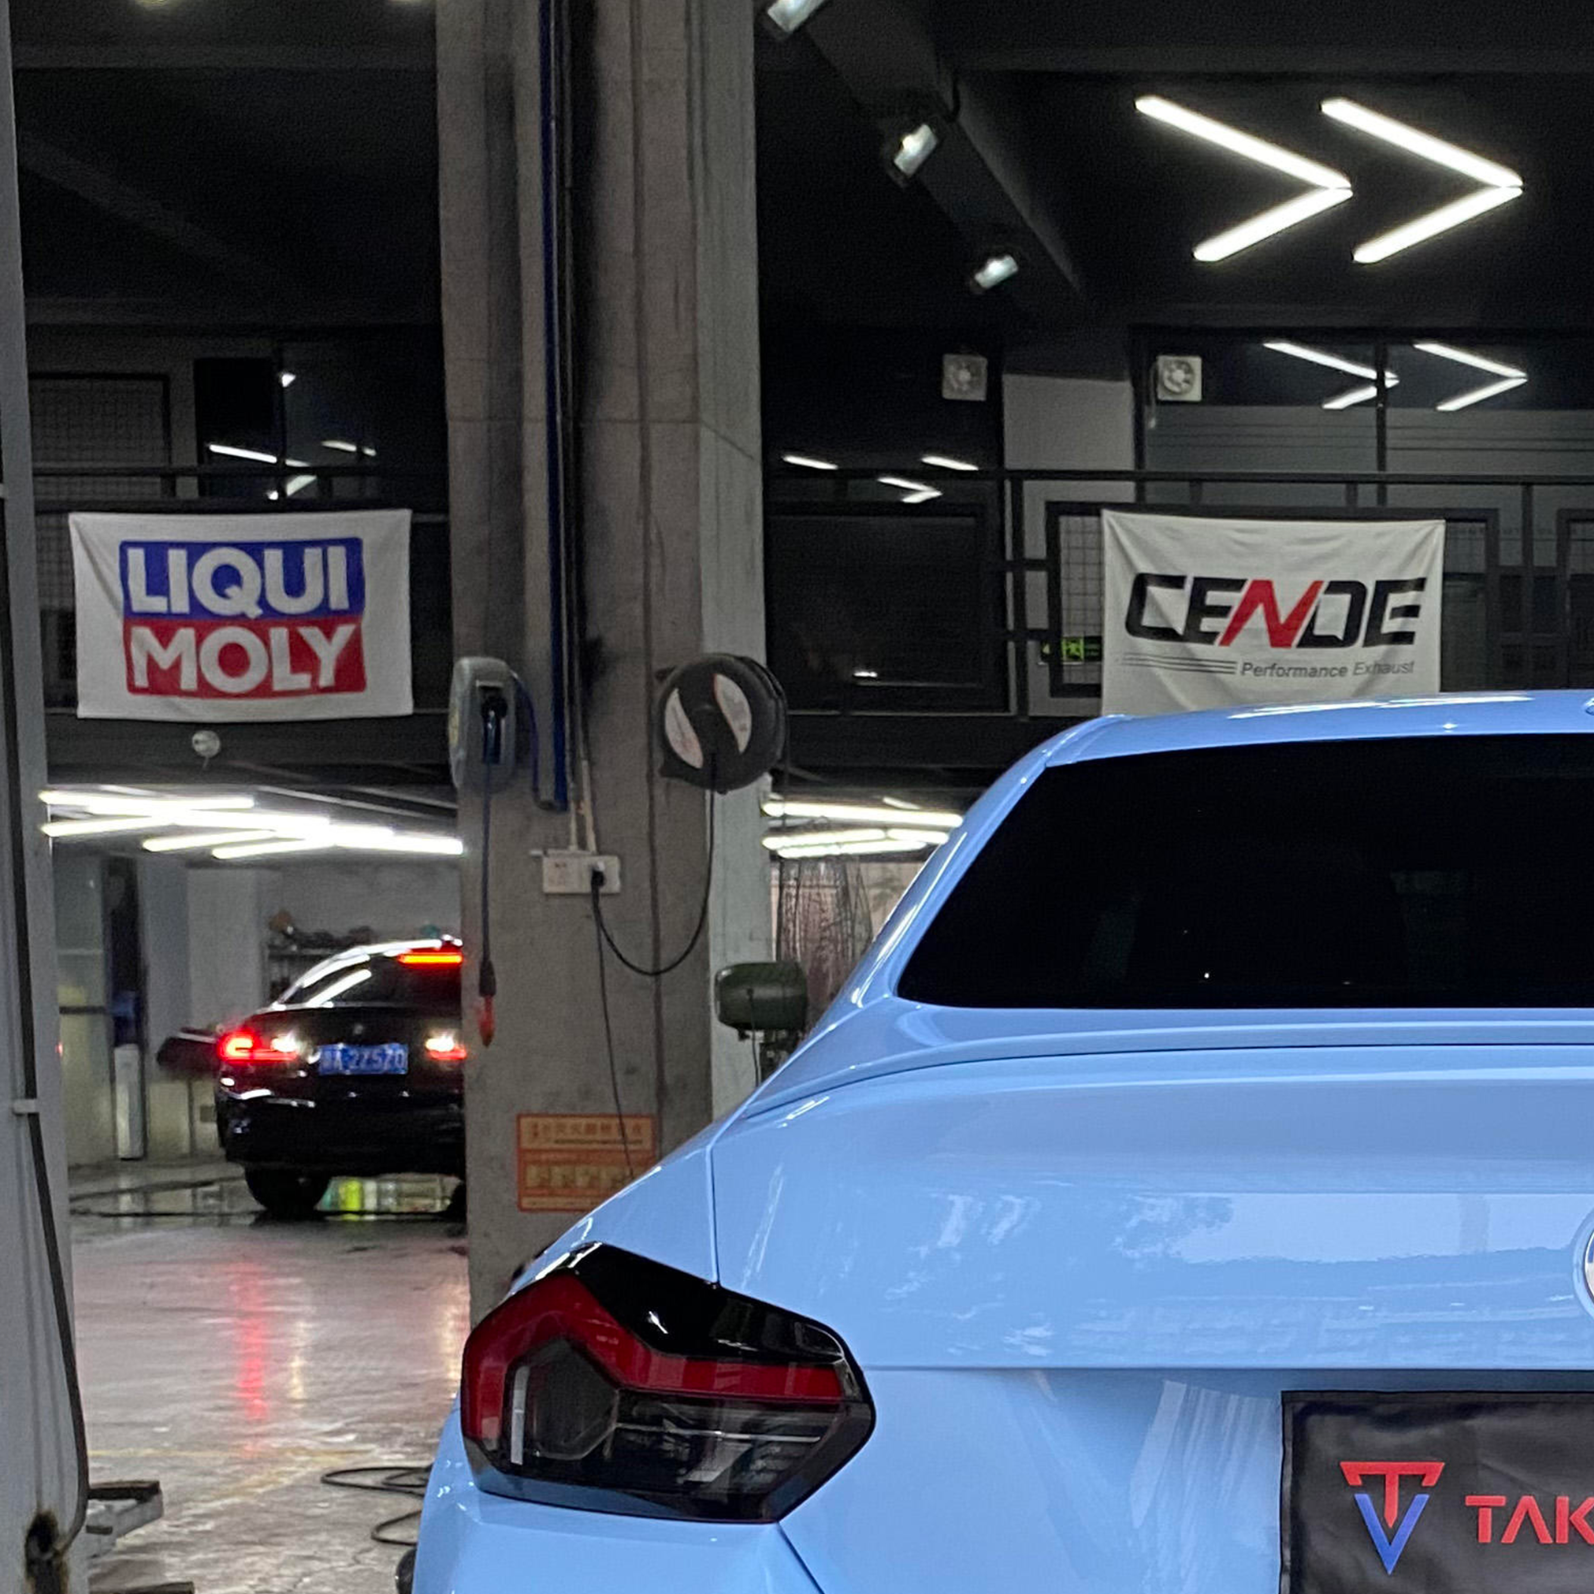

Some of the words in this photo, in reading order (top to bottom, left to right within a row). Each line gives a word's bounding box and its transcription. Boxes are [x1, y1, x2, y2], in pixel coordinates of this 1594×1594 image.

[127, 545, 350, 618] LIQUI
[1124, 572, 1427, 649] CENDE
[130, 624, 357, 694] MOLY
[1240, 661, 1348, 678] Performance
[1352, 660, 1415, 676] Exhaust
